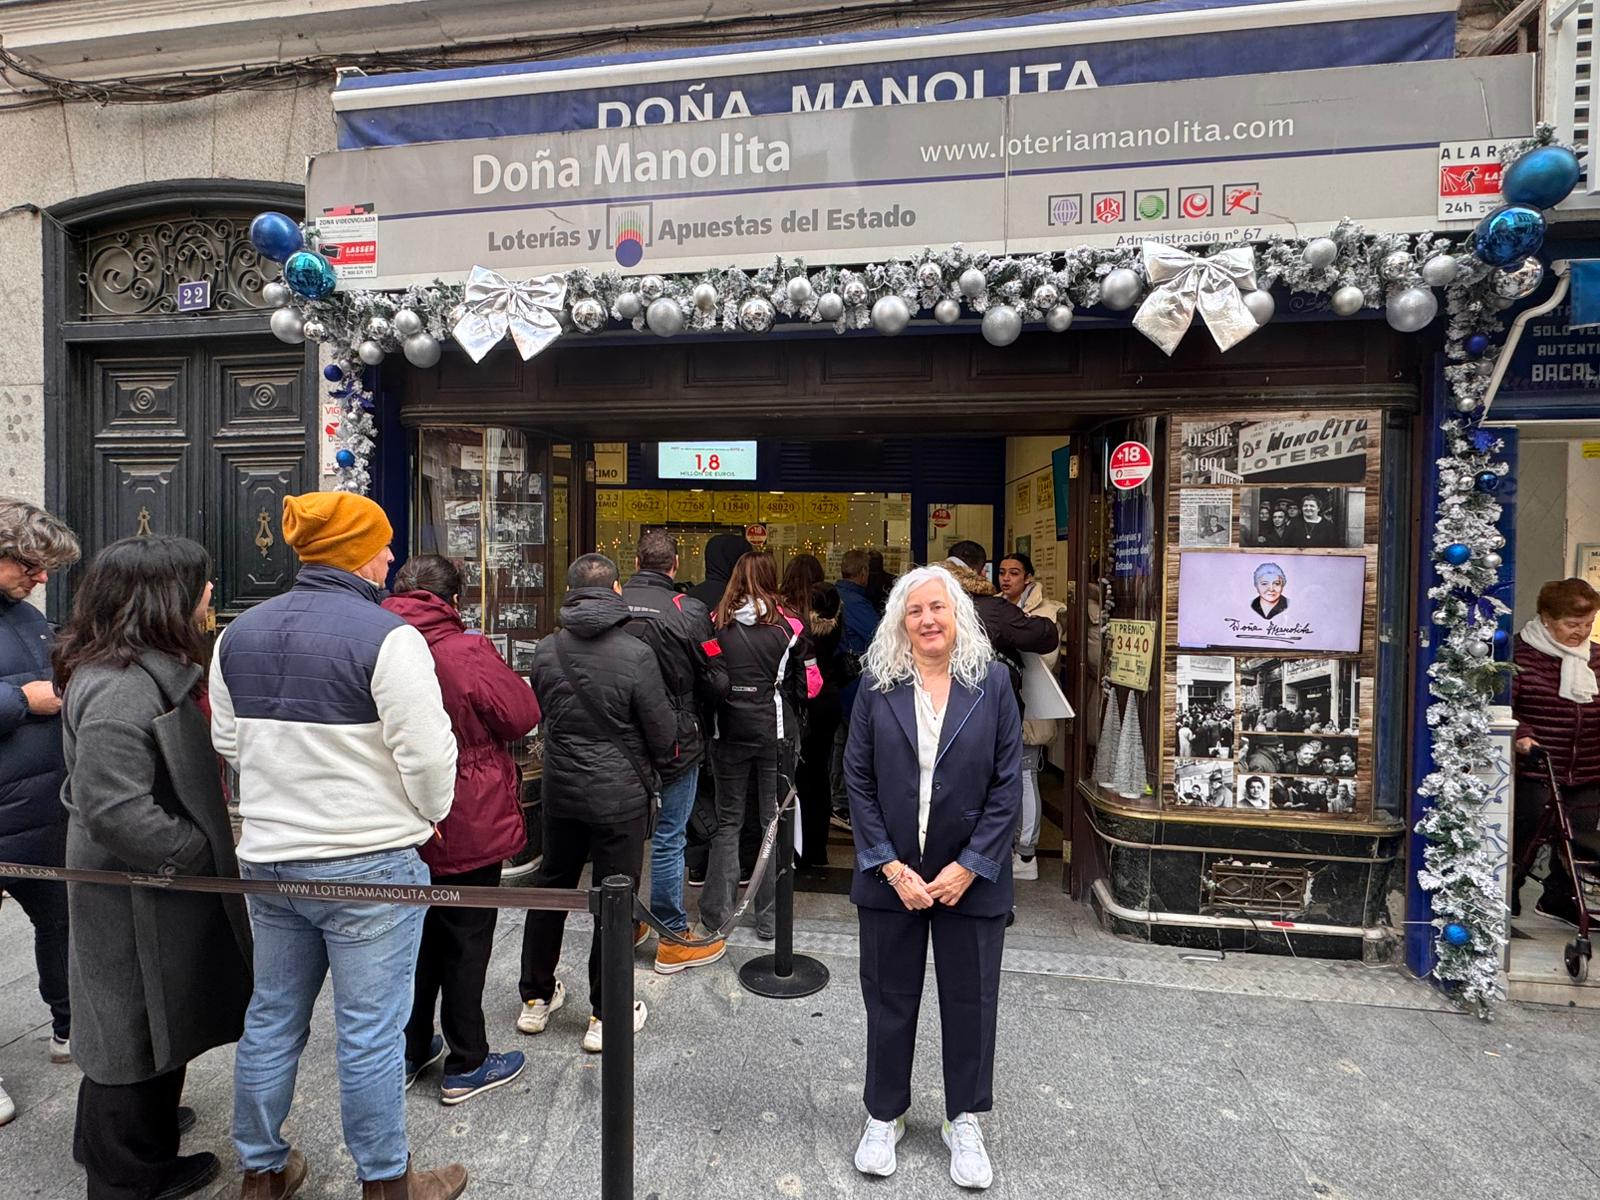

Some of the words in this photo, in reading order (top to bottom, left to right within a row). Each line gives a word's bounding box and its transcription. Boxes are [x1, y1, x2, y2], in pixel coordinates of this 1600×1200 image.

[598, 83, 752, 129] DOÑA
[920, 115, 1295, 163] www.loteriamanolita.com
[1441, 145, 1497, 160] ALAR
[472, 149, 580, 195] Doña
[594, 131, 791, 185] Manolita
[1445, 202, 1472, 214] 24h
[488, 226, 581, 252] Loterías
[586, 228, 601, 251] y
[658, 212, 773, 246] Apuestas
[780, 209, 820, 233] del
[826, 204, 917, 231] Estado
[1243, 227, 1262, 240] 67
[345, 245, 375, 254] LASSER
[183, 287, 203, 305] 22
[1532, 325, 1571, 337] SOLO
[1531, 362, 1600, 383] BACAL
[1188, 432, 1233, 447] DESDE
[695, 453, 720, 473] 1,8
[1117, 446, 1141, 463] +18
[1194, 456, 1226, 472] 1904
[1119, 623, 1145, 636] PREMIO
[276, 882, 461, 902] WWW.LOTERIAMANOLITA.COM
